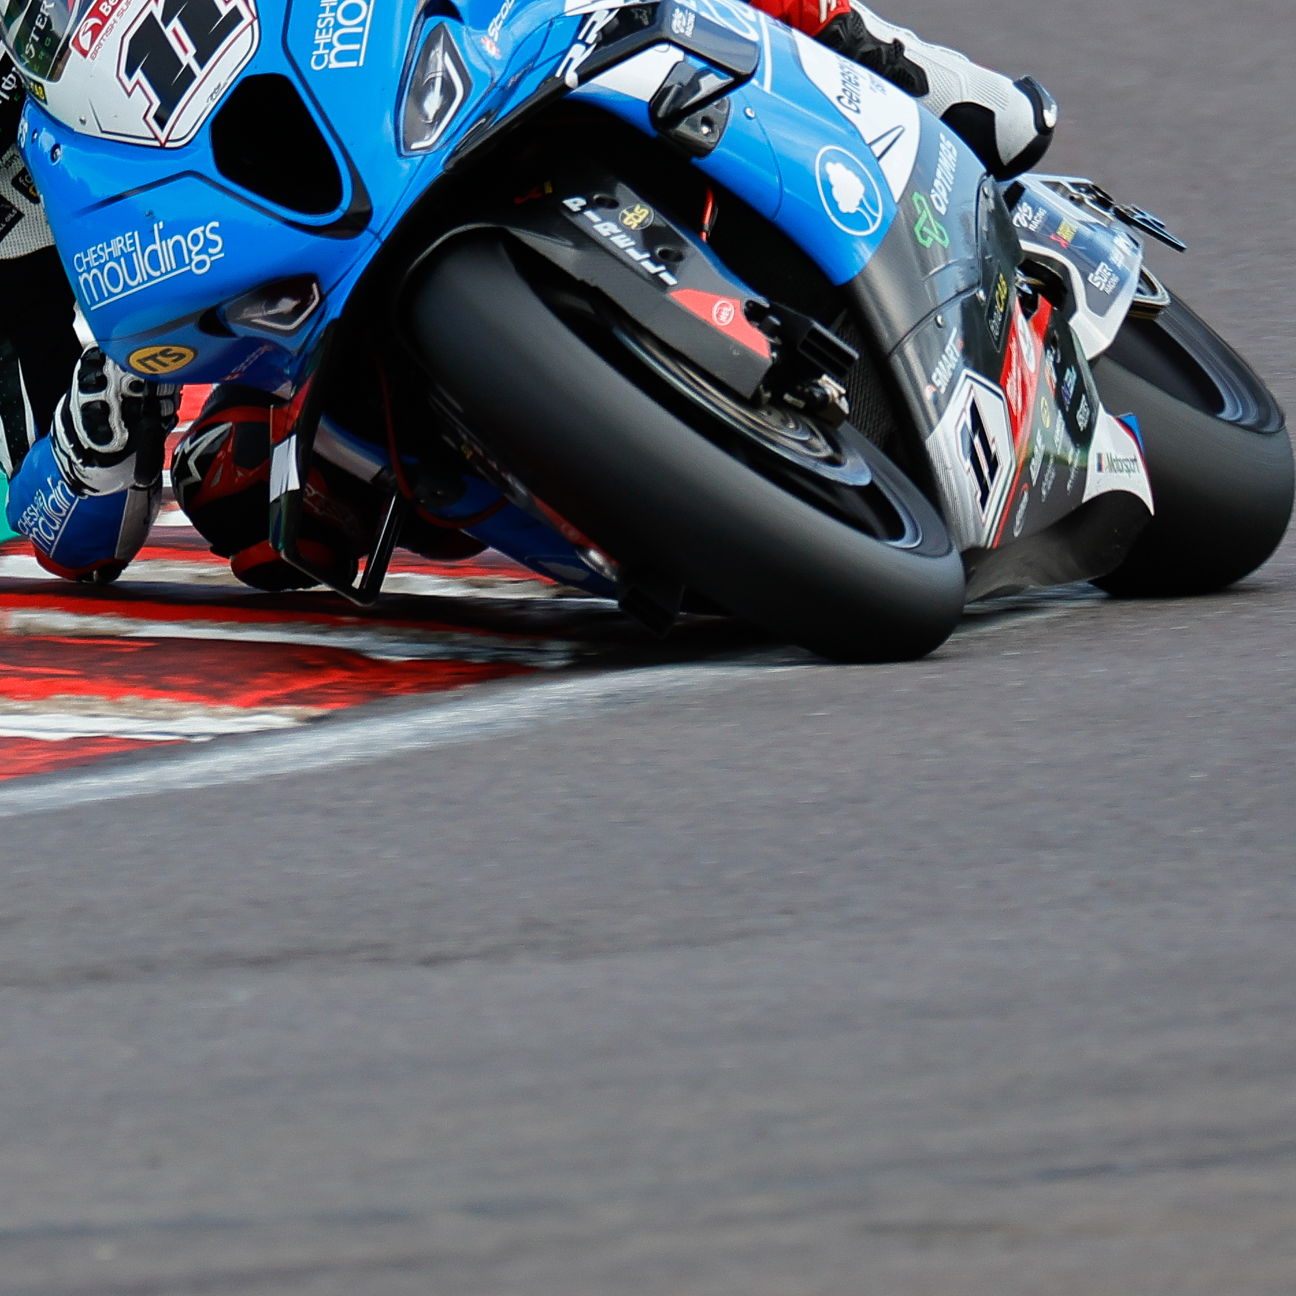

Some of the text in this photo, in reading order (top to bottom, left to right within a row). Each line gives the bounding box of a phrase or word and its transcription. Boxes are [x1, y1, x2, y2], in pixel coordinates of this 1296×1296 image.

[74, 232, 136, 273] CHESHIRE
[78, 221, 223, 306] mouldings
[135, 348, 187, 372] ITS
